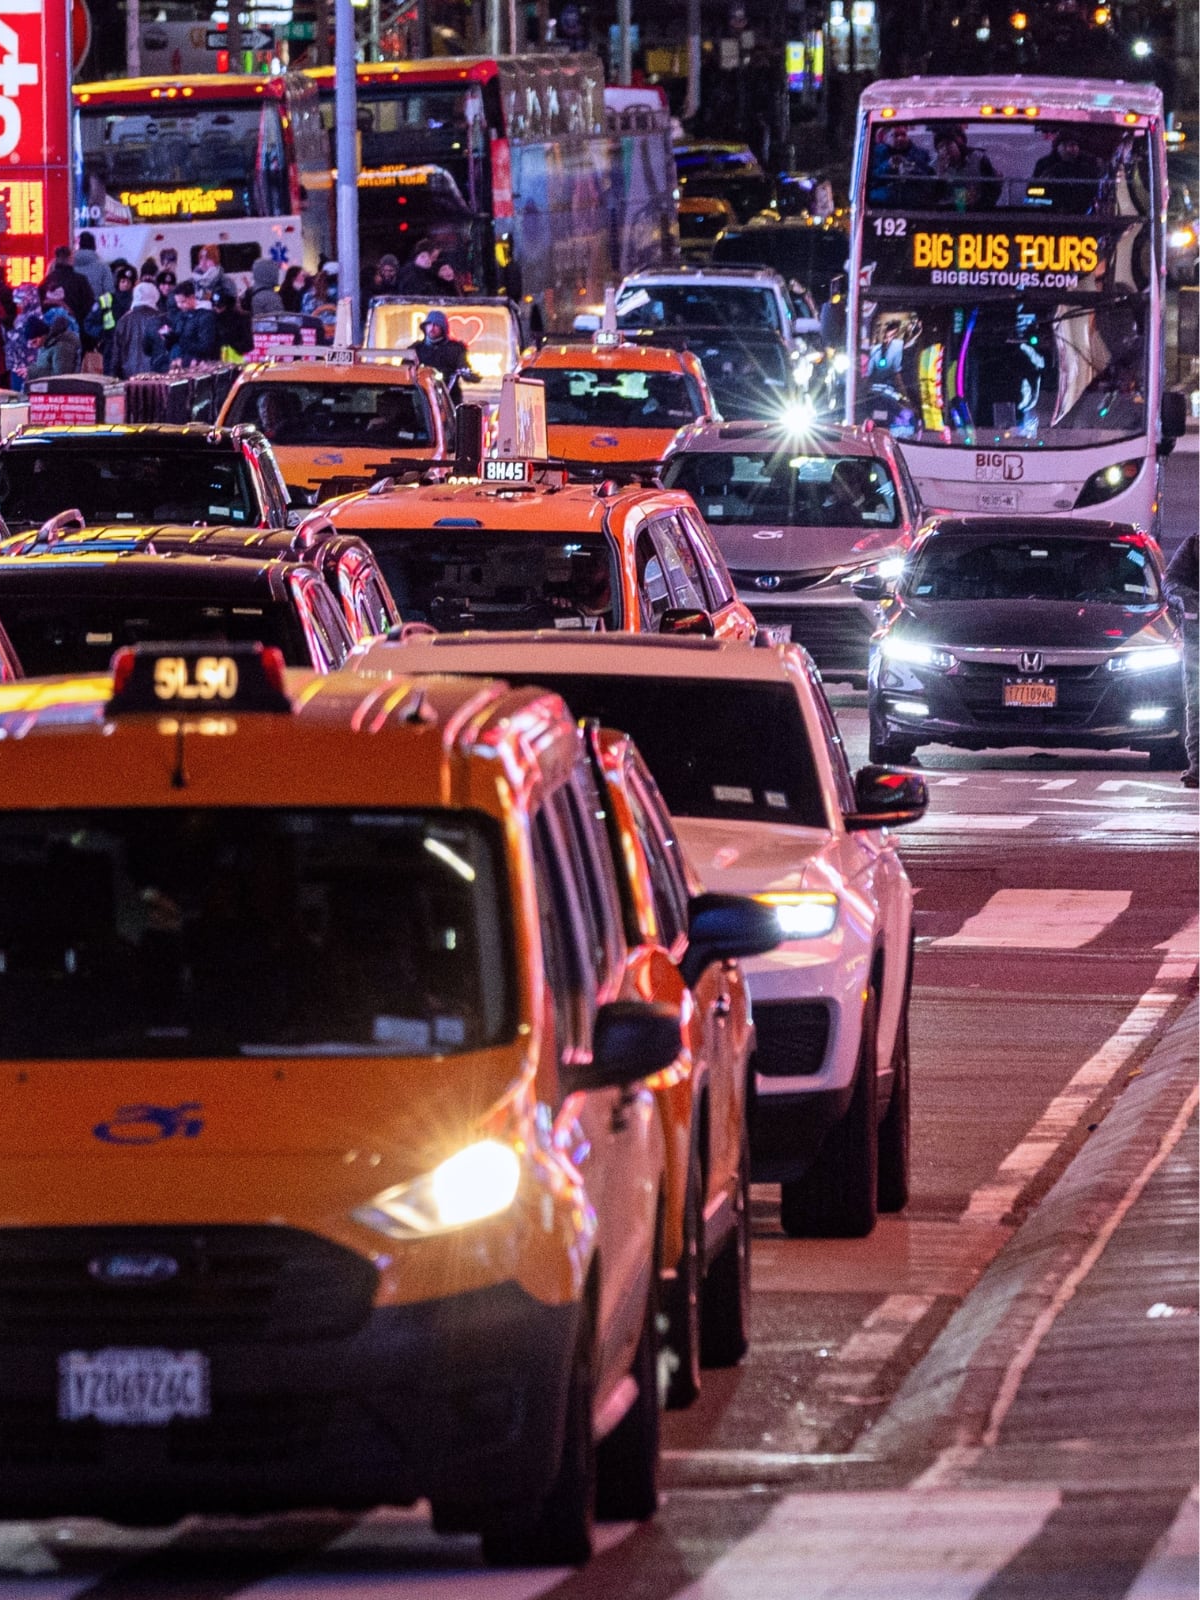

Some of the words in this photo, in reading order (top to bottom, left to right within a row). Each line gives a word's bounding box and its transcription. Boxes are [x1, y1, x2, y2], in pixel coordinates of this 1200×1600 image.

[180, 199, 217, 214] TOUR
[873, 218, 907, 236] 192
[913, 232, 953, 268] BIG
[957, 233, 1009, 269] BUS
[1015, 235, 1098, 271] TOURS
[931, 271, 1078, 287] BIGBUSTOURS.COM
[976, 453, 1002, 467] BIG
[486, 461, 524, 480] 8H45
